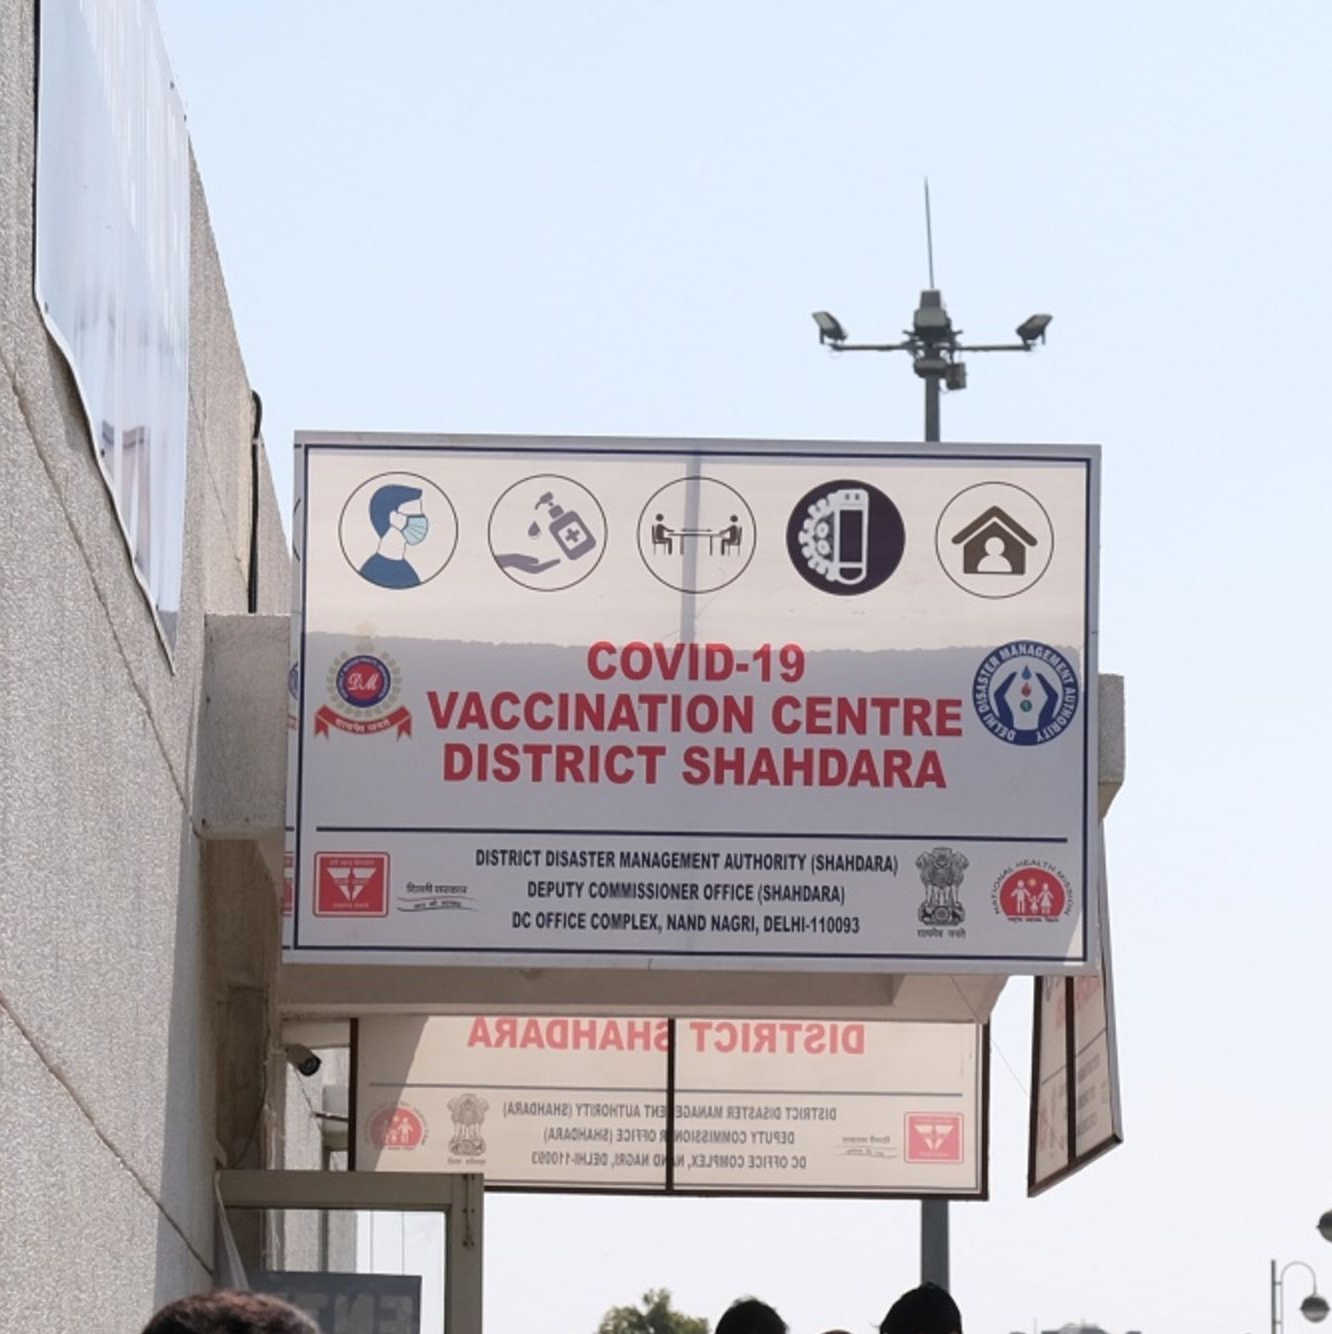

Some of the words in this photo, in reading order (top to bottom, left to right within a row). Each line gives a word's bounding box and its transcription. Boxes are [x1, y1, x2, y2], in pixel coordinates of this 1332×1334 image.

[587, 640, 806, 683] COVID-19
[998, 643, 1075, 684] MANAGEMENT
[975, 656, 1001, 713] DISASTER
[426, 690, 754, 734] VACCINATION
[771, 694, 963, 737] CENTRE
[982, 712, 1017, 742] DELHI
[1035, 686, 1077, 743] AUTHORITY
[443, 742, 666, 785] DISTRICT
[682, 745, 947, 789] SHAHDARA
[475, 849, 541, 867] DISTRICT
[545, 850, 616, 868] DISASTER
[619, 851, 720, 870] MANAGEMENT
[724, 853, 807, 871] AUTHORITY
[811, 853, 899, 877] (SHAHDARA)
[1015, 859, 1057, 872] HEALTH
[527, 880, 584, 898] DEPUTY
[588, 881, 699, 900] COMMISSIONER
[703, 883, 754, 901] OFFICE
[757, 884, 845, 906] (SHAHDARA)
[511, 911, 531, 929] DC
[535, 911, 587, 929] OFFICE
[590, 912, 663, 934] COMPLEX,
[667, 914, 707, 931] NAND
[711, 914, 759, 936] NAGRI,
[763, 915, 861, 934] DELHI-110093
